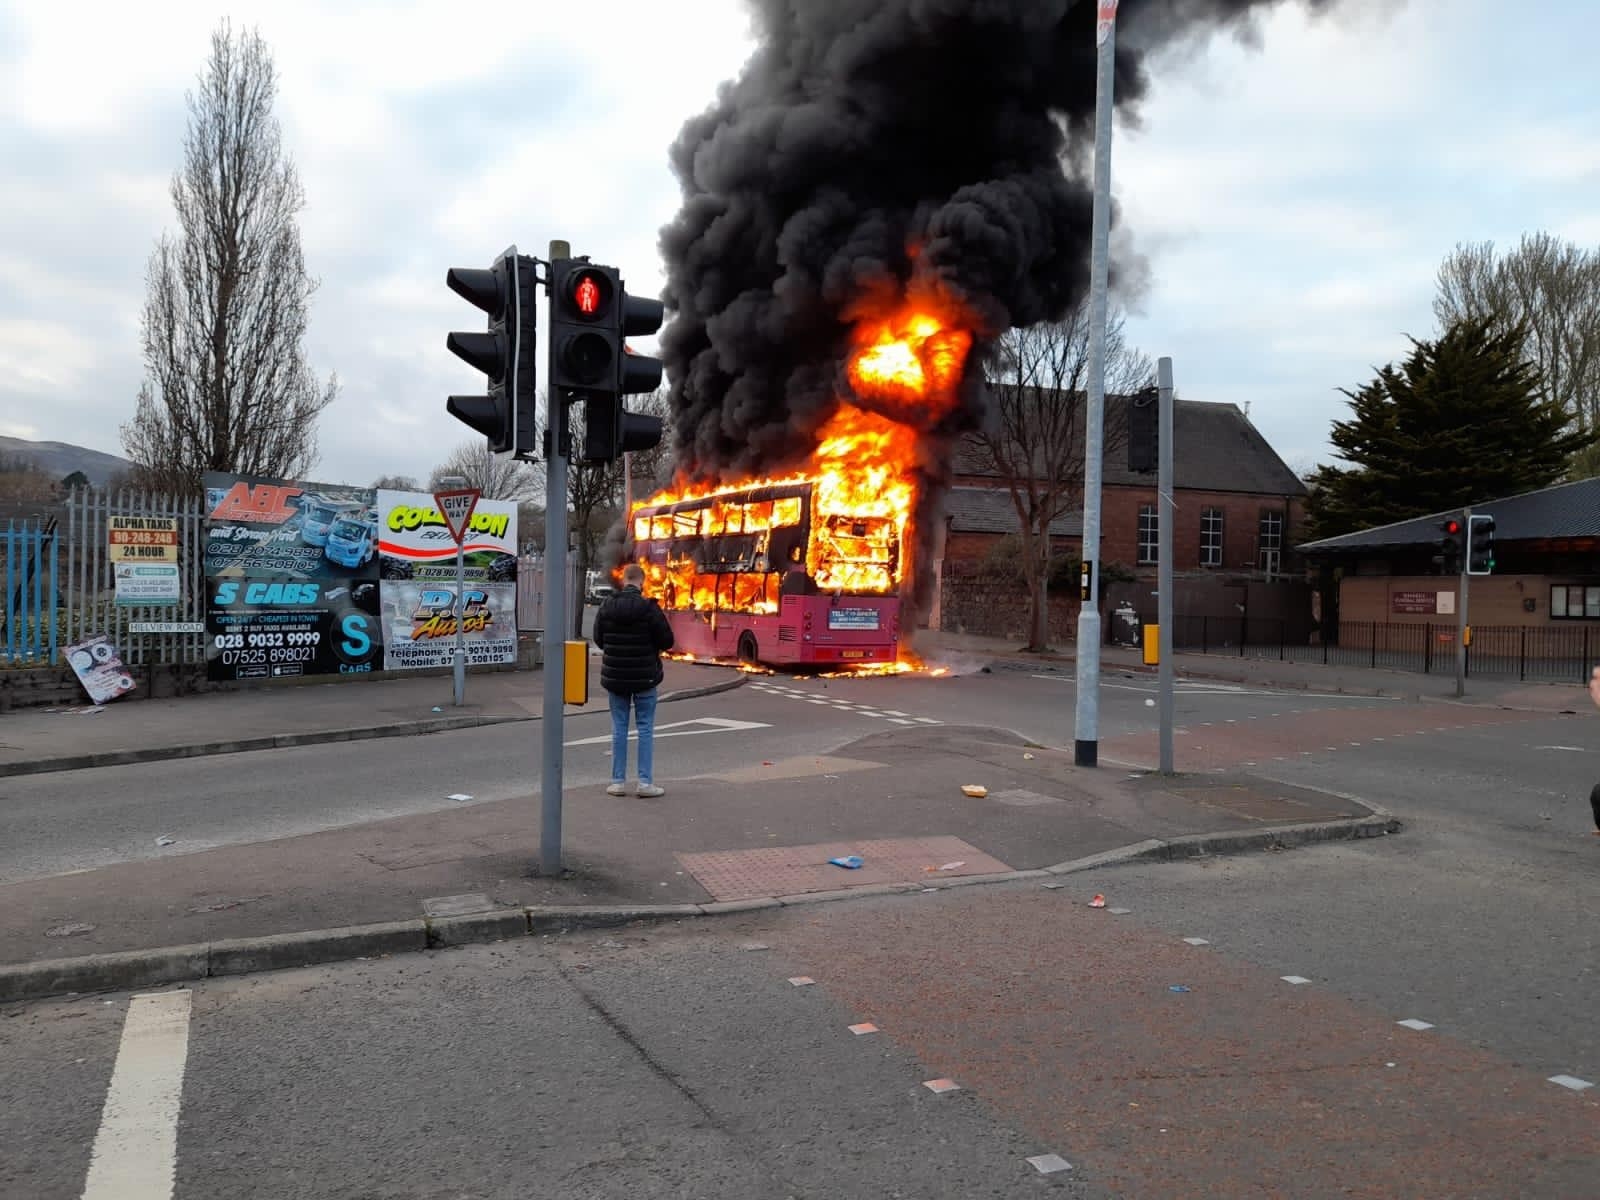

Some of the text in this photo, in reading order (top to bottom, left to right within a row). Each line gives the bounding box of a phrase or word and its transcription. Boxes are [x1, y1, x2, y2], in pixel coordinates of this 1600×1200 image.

[208, 482, 304, 523] ABC
[444, 497, 470, 509] GIVE
[448, 510, 466, 518] WAY
[113, 518, 173, 530] ALPHA TAXIS
[387, 505, 509, 538] COLLION
[123, 546, 164, 557] 24 HOUR
[208, 543, 324, 558] 028 9074 9898
[212, 556, 317, 570] 07756 508105
[214, 581, 320, 605] S CABS
[131, 623, 202, 632] HILLVIEW ROAD
[410, 616, 494, 641] Auos
[214, 632, 321, 648] 028 9032 9999
[341, 614, 371, 656] S
[222, 647, 316, 665] 07525 898021
[390, 648, 446, 658] Telephone:
[468, 646, 490, 655] 9074
[339, 662, 372, 674] CABS
[401, 658, 438, 667] Mobile:
